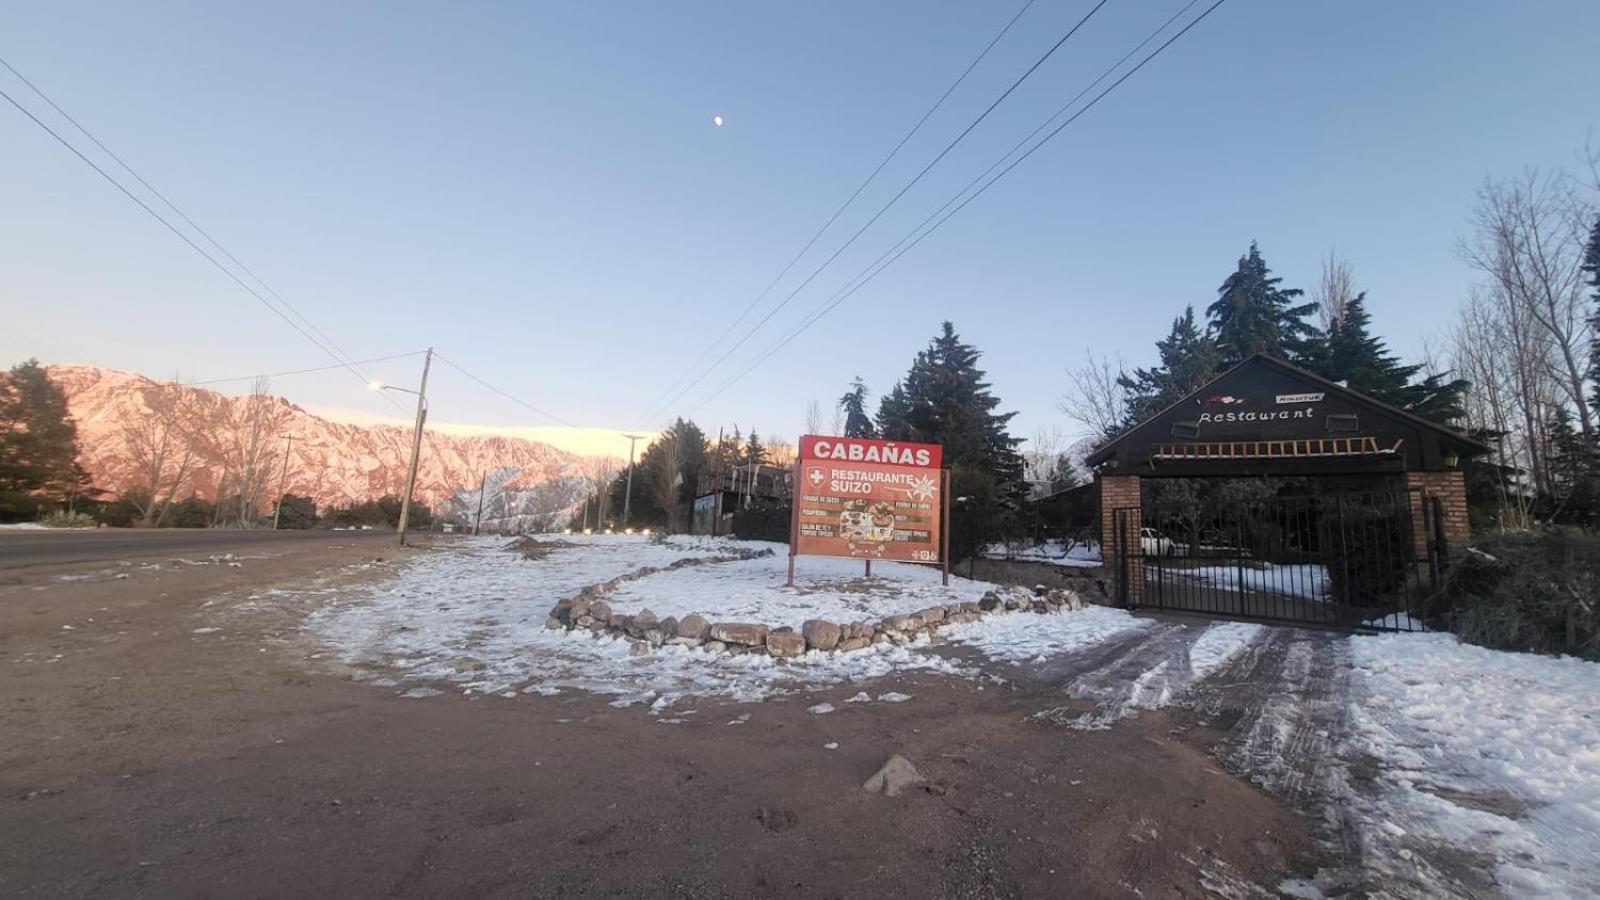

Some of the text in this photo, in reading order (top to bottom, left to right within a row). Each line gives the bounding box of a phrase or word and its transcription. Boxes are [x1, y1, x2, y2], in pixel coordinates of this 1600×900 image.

[1198, 408, 1313, 424] Restaurant
[814, 442, 930, 466] CABAÑAS
[831, 469, 914, 484] RESTAURANTE
[830, 480, 872, 494] SUIZO
